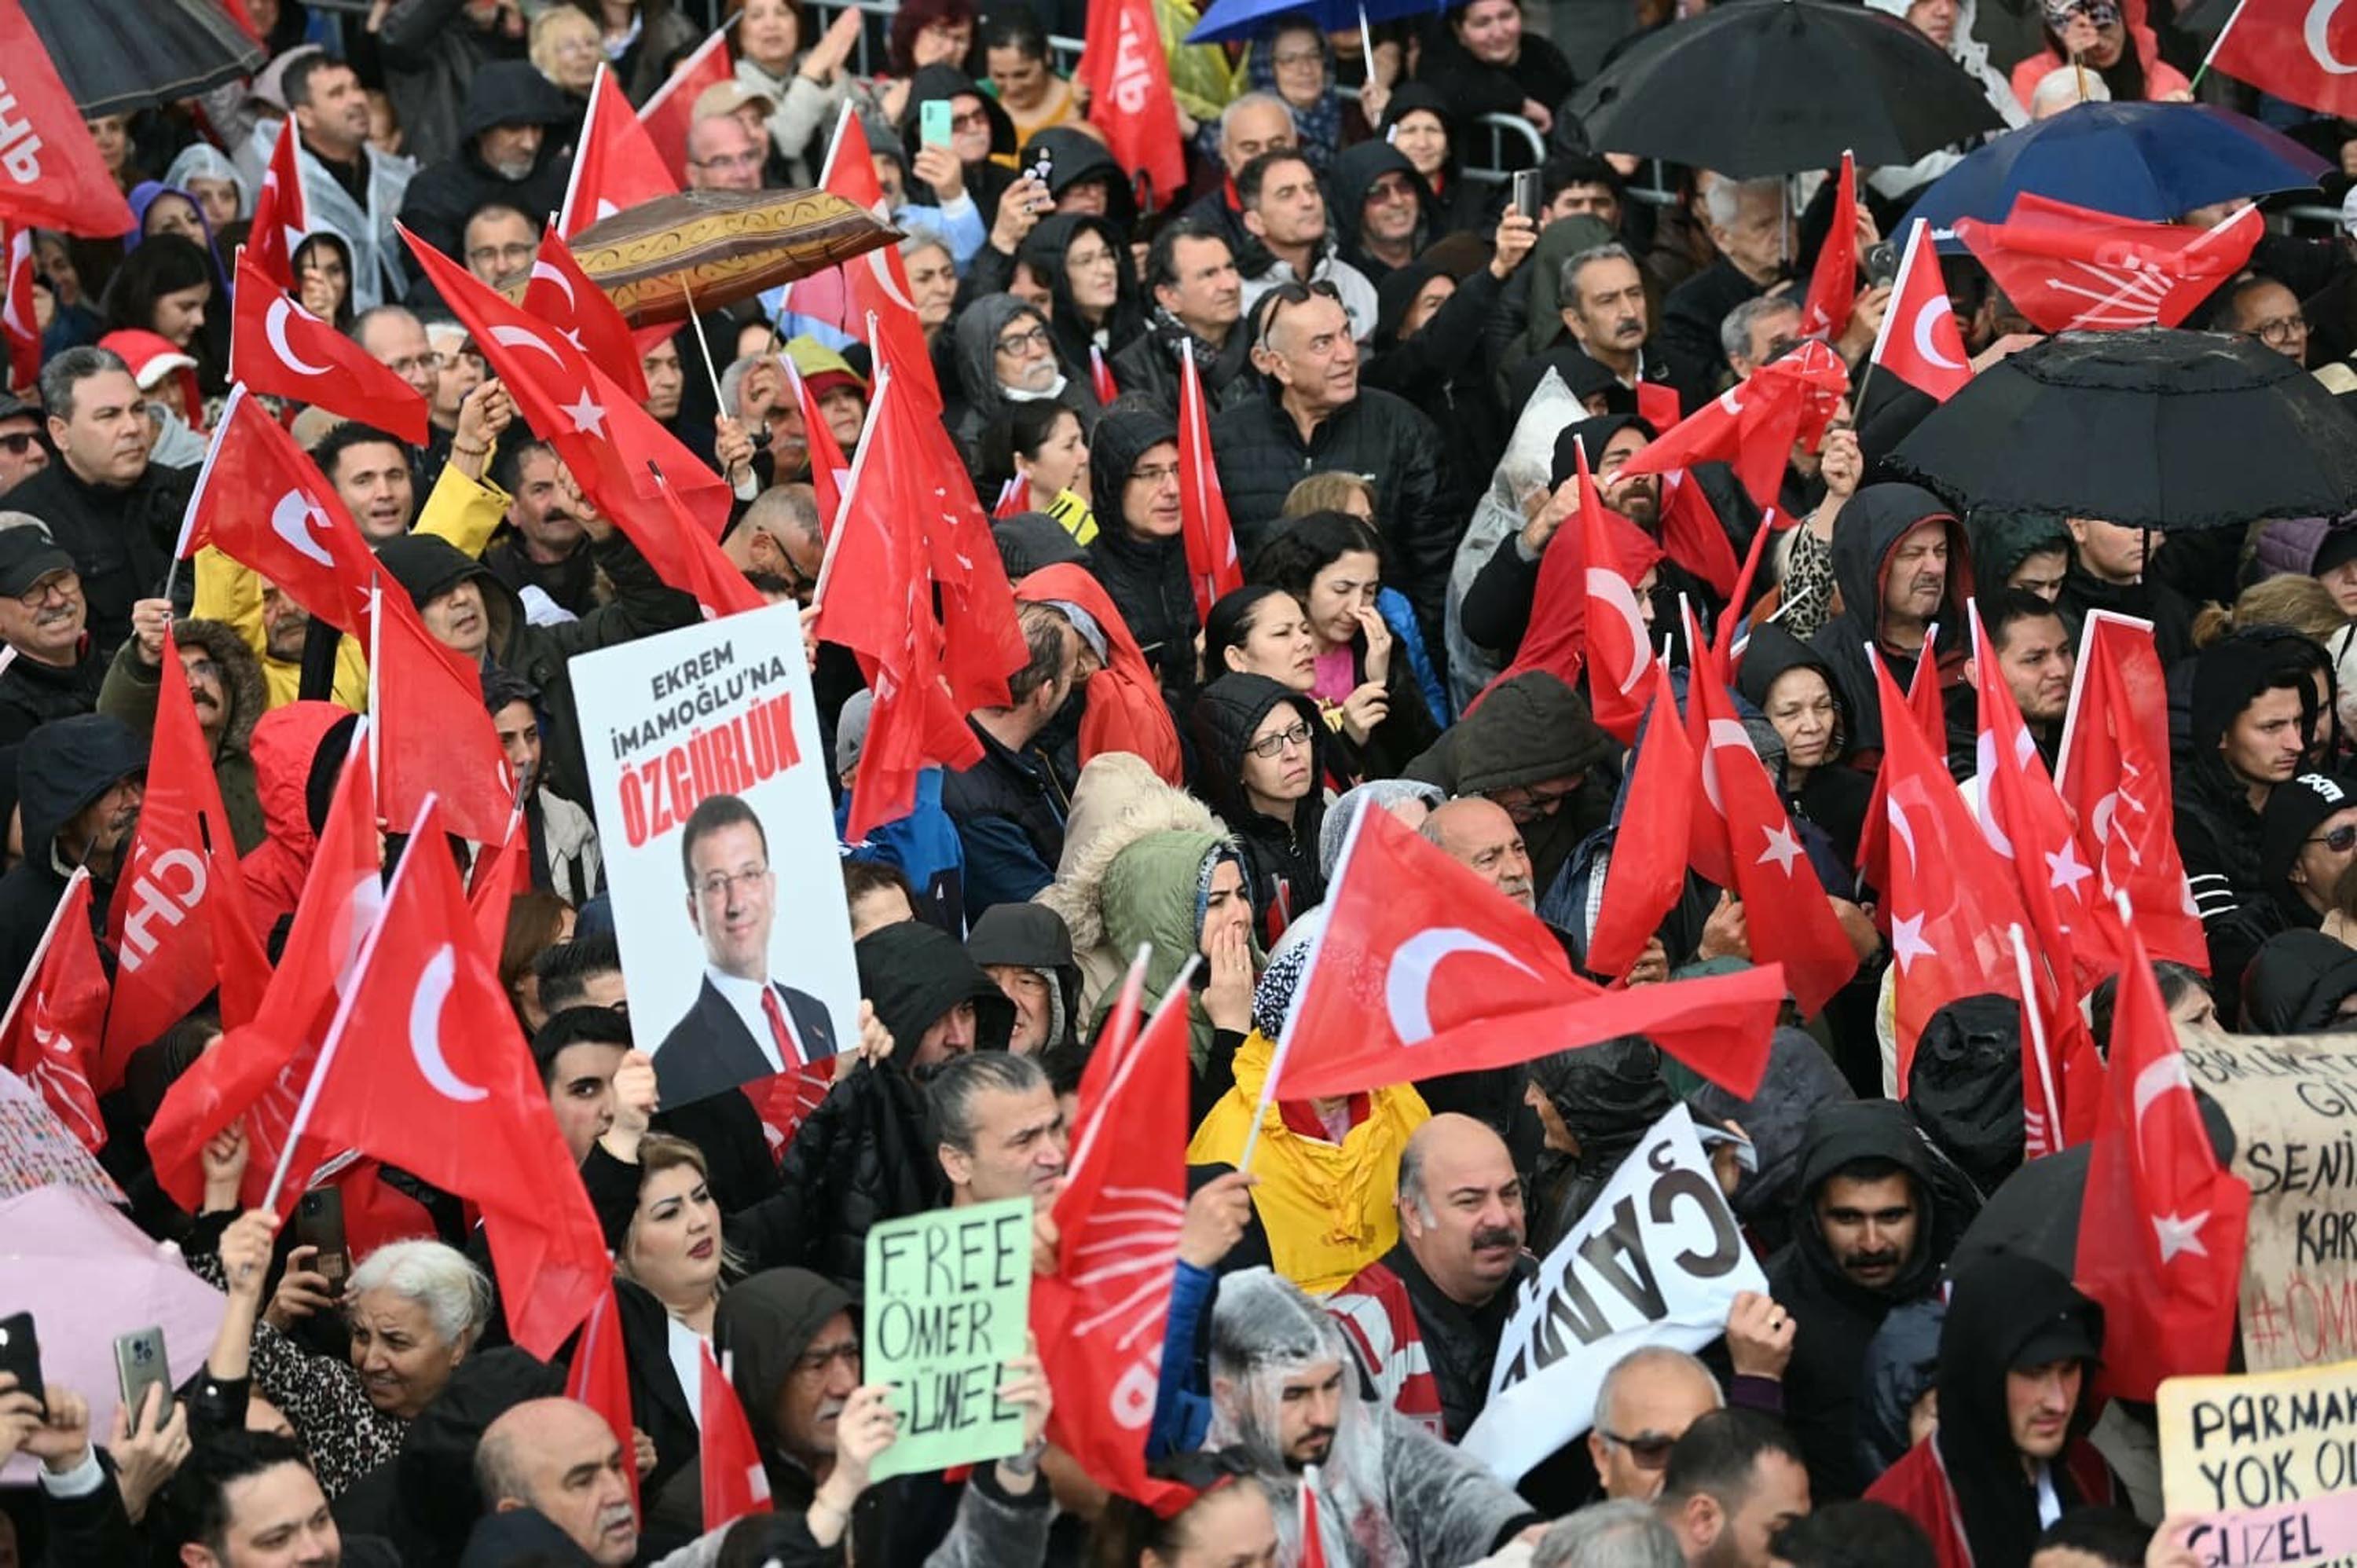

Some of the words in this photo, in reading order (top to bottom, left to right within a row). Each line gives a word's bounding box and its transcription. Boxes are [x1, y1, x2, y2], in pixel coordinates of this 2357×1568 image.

[0, 76, 43, 185] HP
[610, 654, 786, 760] İMAMOĞLU'NA
[651, 640, 735, 701] EKREM
[618, 691, 802, 848] ÖZGÜRLÜK
[880, 1214, 1023, 1297] FREE
[2297, 1209, 2357, 1266] KAR
[878, 1289, 993, 1362] ÖMER
[2199, 1449, 2300, 1512] YOK
